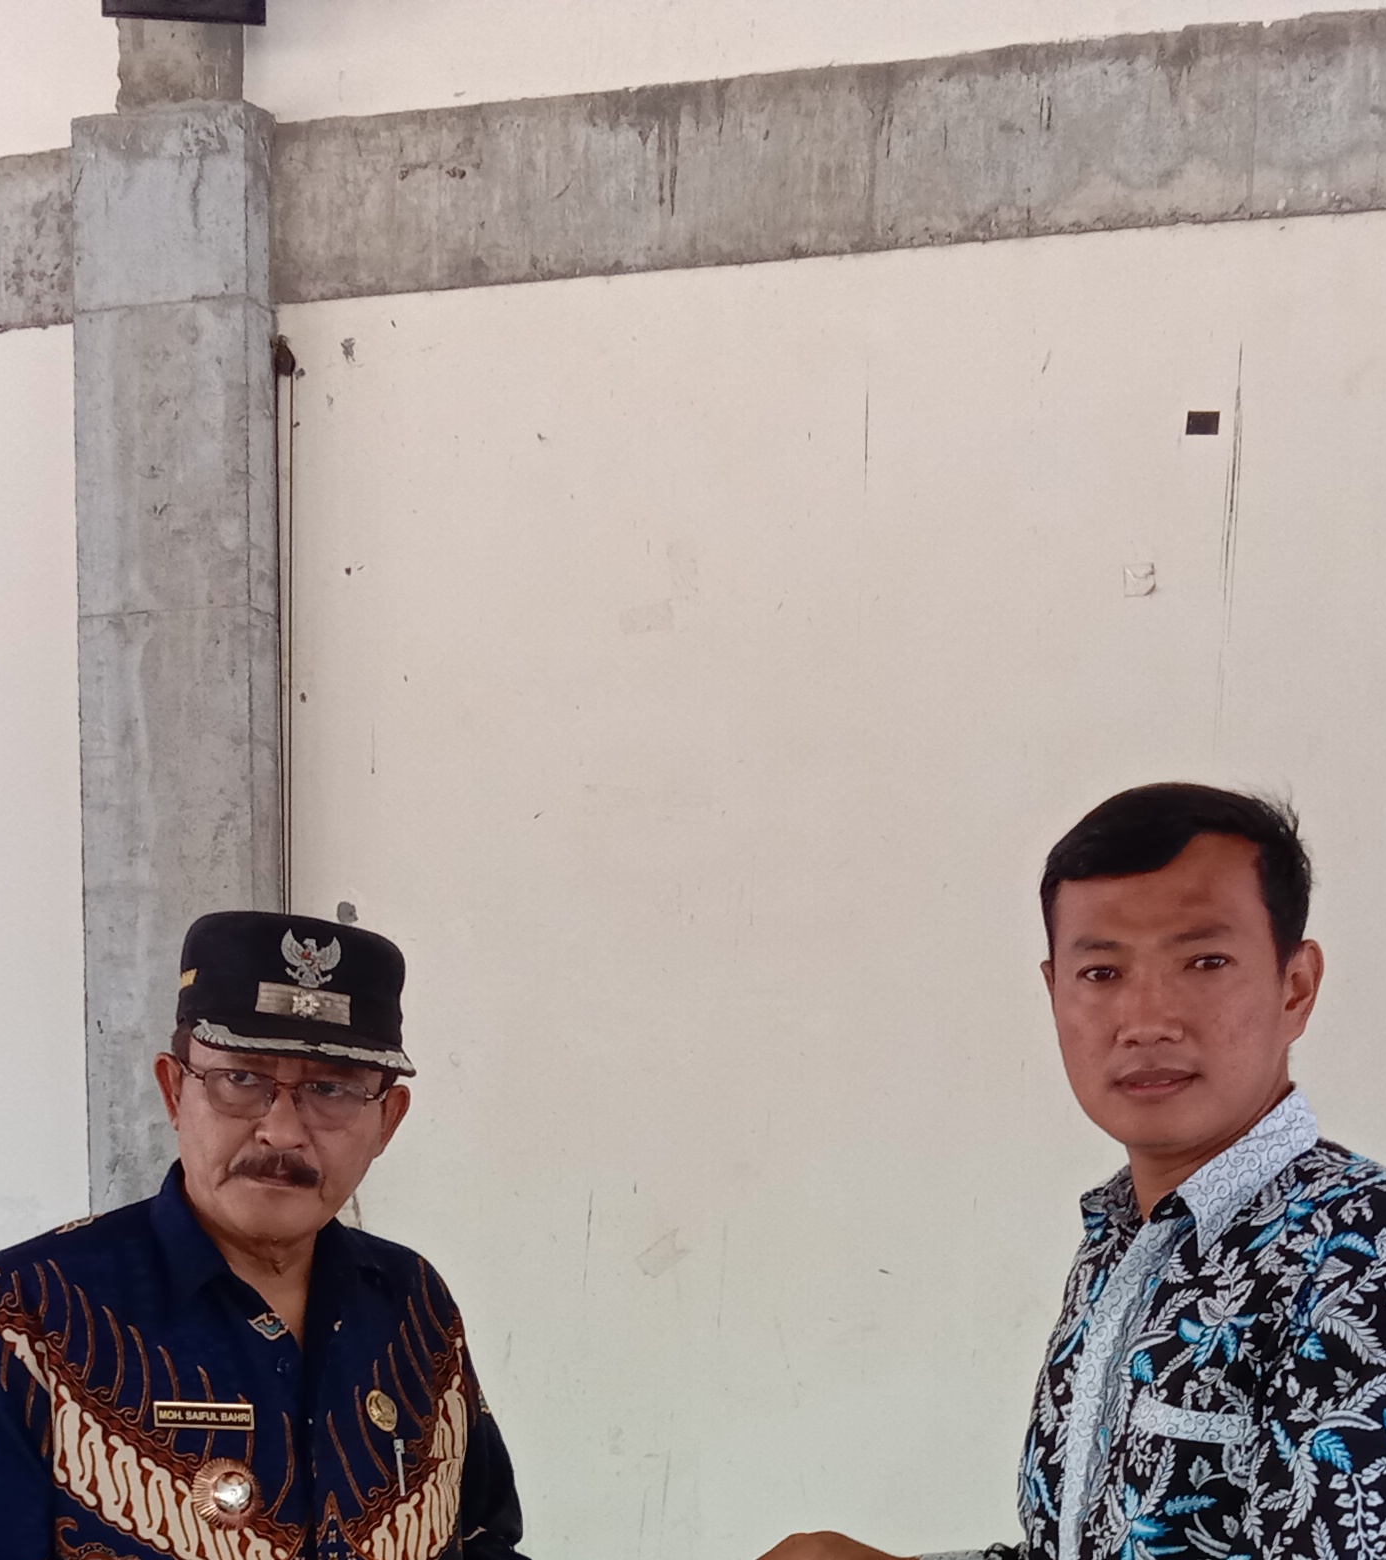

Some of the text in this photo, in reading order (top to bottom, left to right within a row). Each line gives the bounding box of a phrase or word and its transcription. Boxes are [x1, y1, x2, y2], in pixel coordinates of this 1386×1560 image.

[159, 1410, 250, 1422] MOH. SAIFUL BAHRI
